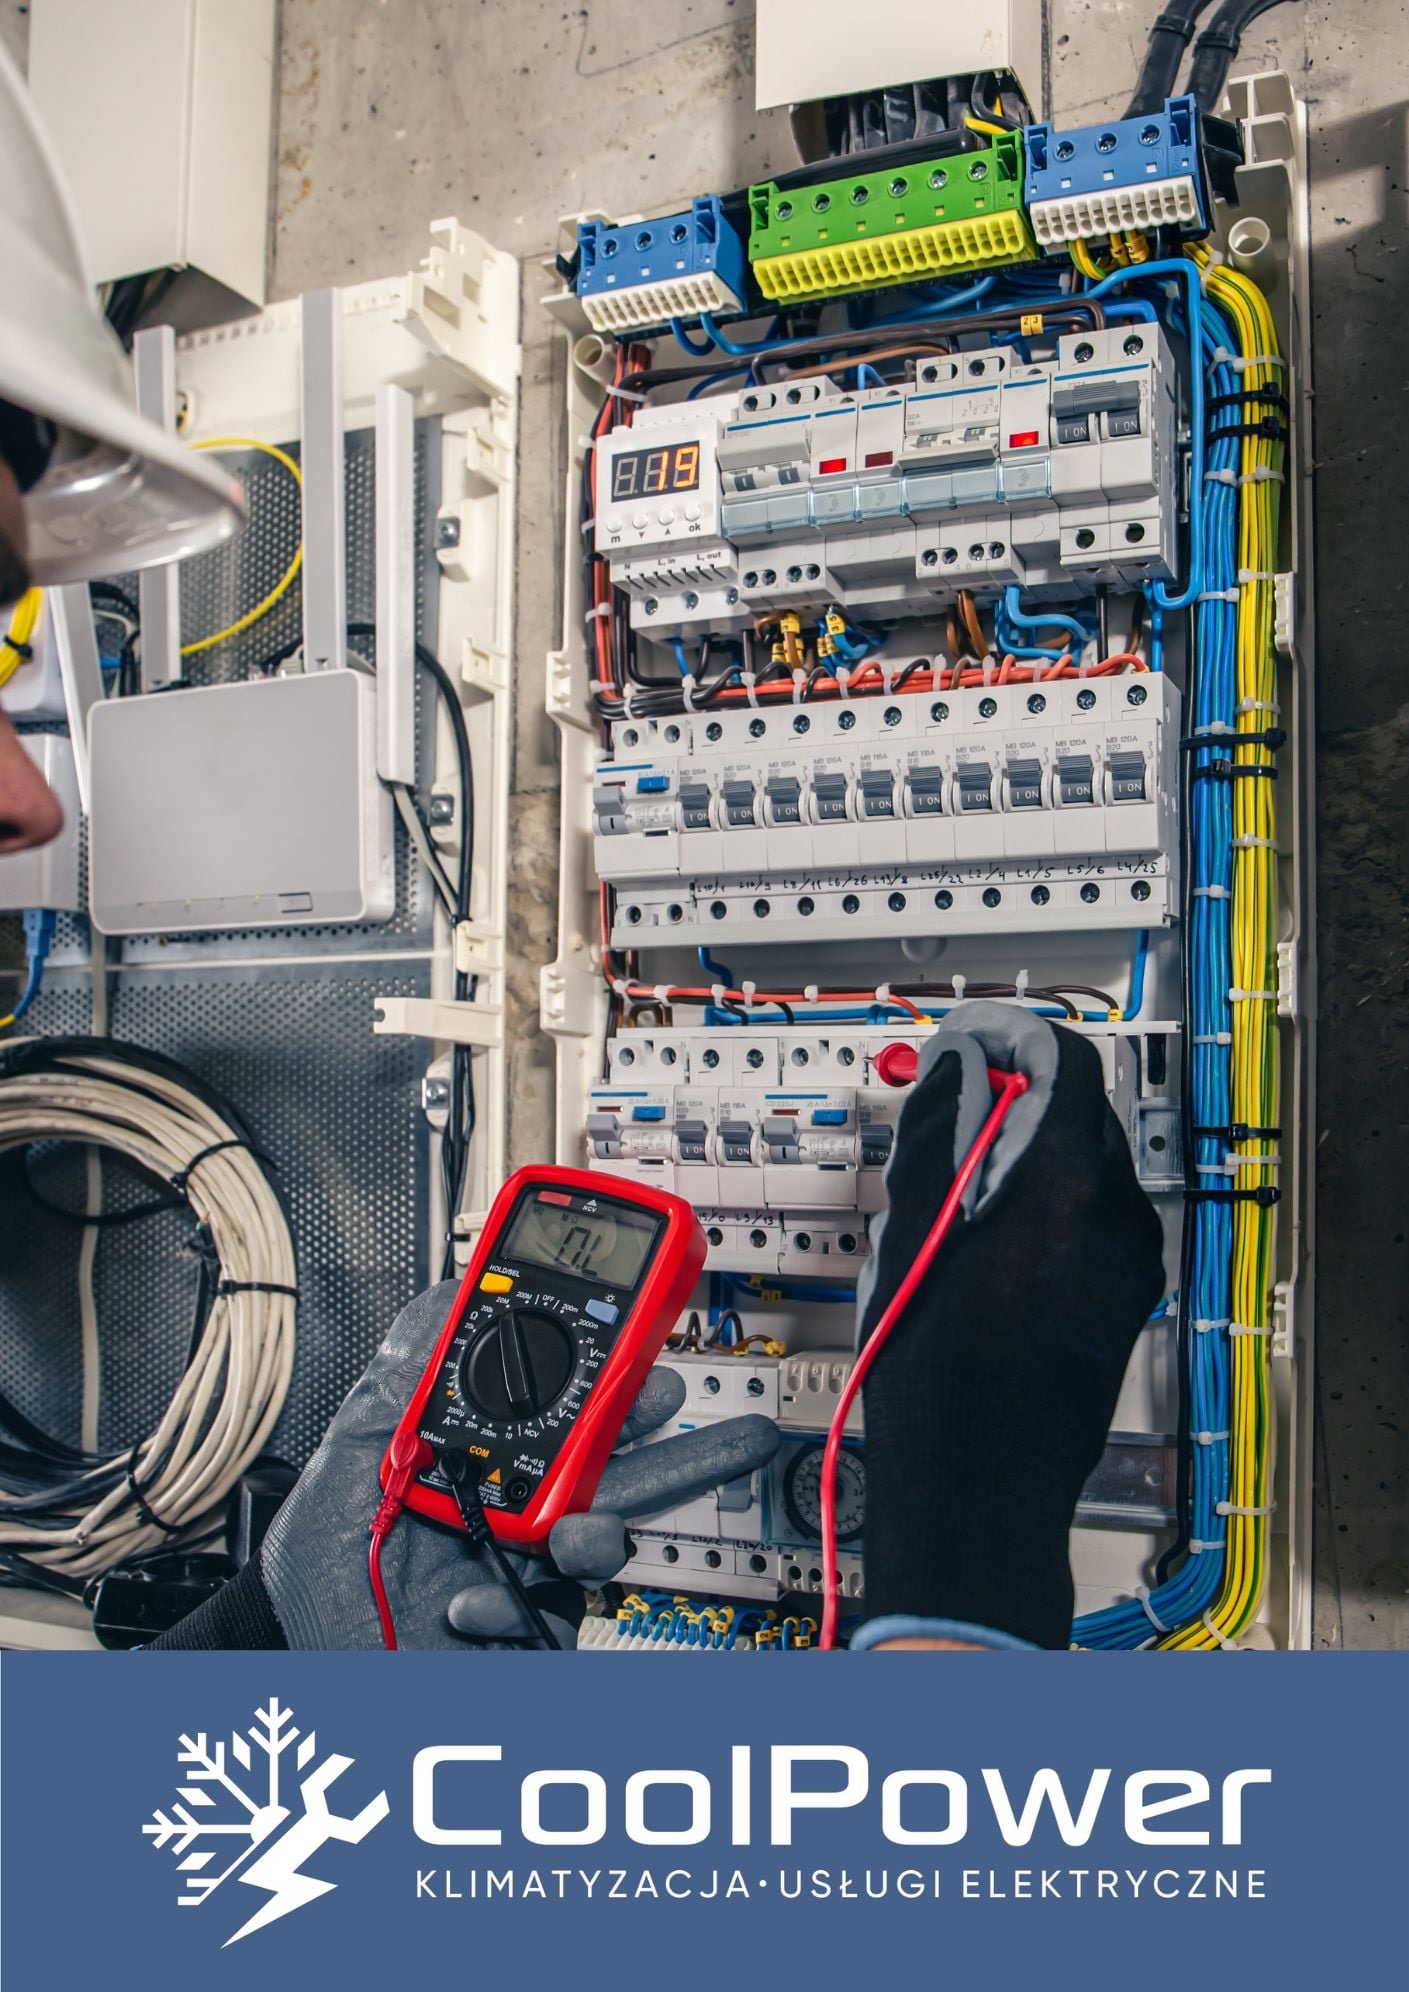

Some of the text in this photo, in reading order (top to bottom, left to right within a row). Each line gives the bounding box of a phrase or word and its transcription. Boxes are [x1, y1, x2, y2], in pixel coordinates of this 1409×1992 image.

[1124, 420, 1138, 432] ON
[1073, 428, 1087, 438] ON
[657, 445, 700, 491] 19
[689, 522, 701, 533] ok
[610, 535, 621, 543] m
[624, 562, 631, 570] N
[707, 552, 722, 560] out
[1076, 787, 1090, 796] ON
[1128, 784, 1142, 792] ON
[976, 794, 989, 802] ON
[1024, 790, 1038, 799] ON
[878, 800, 892, 809] ON
[740, 810, 752, 818] ON
[785, 807, 798, 816] ON
[1017, 865, 1056, 880] L1/5
[1068, 864, 1105, 876] L5/6
[1117, 860, 1158, 874] L4/25
[737, 1148, 750, 1156] ON
[582, 1205, 598, 1213] NCV
[489, 1264, 521, 1278] HOLD/SEL
[496, 1296, 510, 1304] 20M
[516, 1290, 533, 1300] 200M
[542, 1294, 555, 1303] OFF
[562, 1303, 579, 1313] 200m
[578, 1318, 599, 1330] 2000m
[585, 1336, 595, 1344] 20
[445, 1362, 456, 1370] 200
[586, 1360, 599, 1368] 200
[580, 1380, 592, 1390] 600
[568, 1400, 580, 1410] 600
[465, 1420, 479, 1430] 20m
[546, 1418, 560, 1428] 200
[480, 1427, 498, 1438] 200m
[505, 1432, 513, 1440] 10
[524, 1428, 540, 1439] NCV
[469, 1445, 491, 1459] COM
